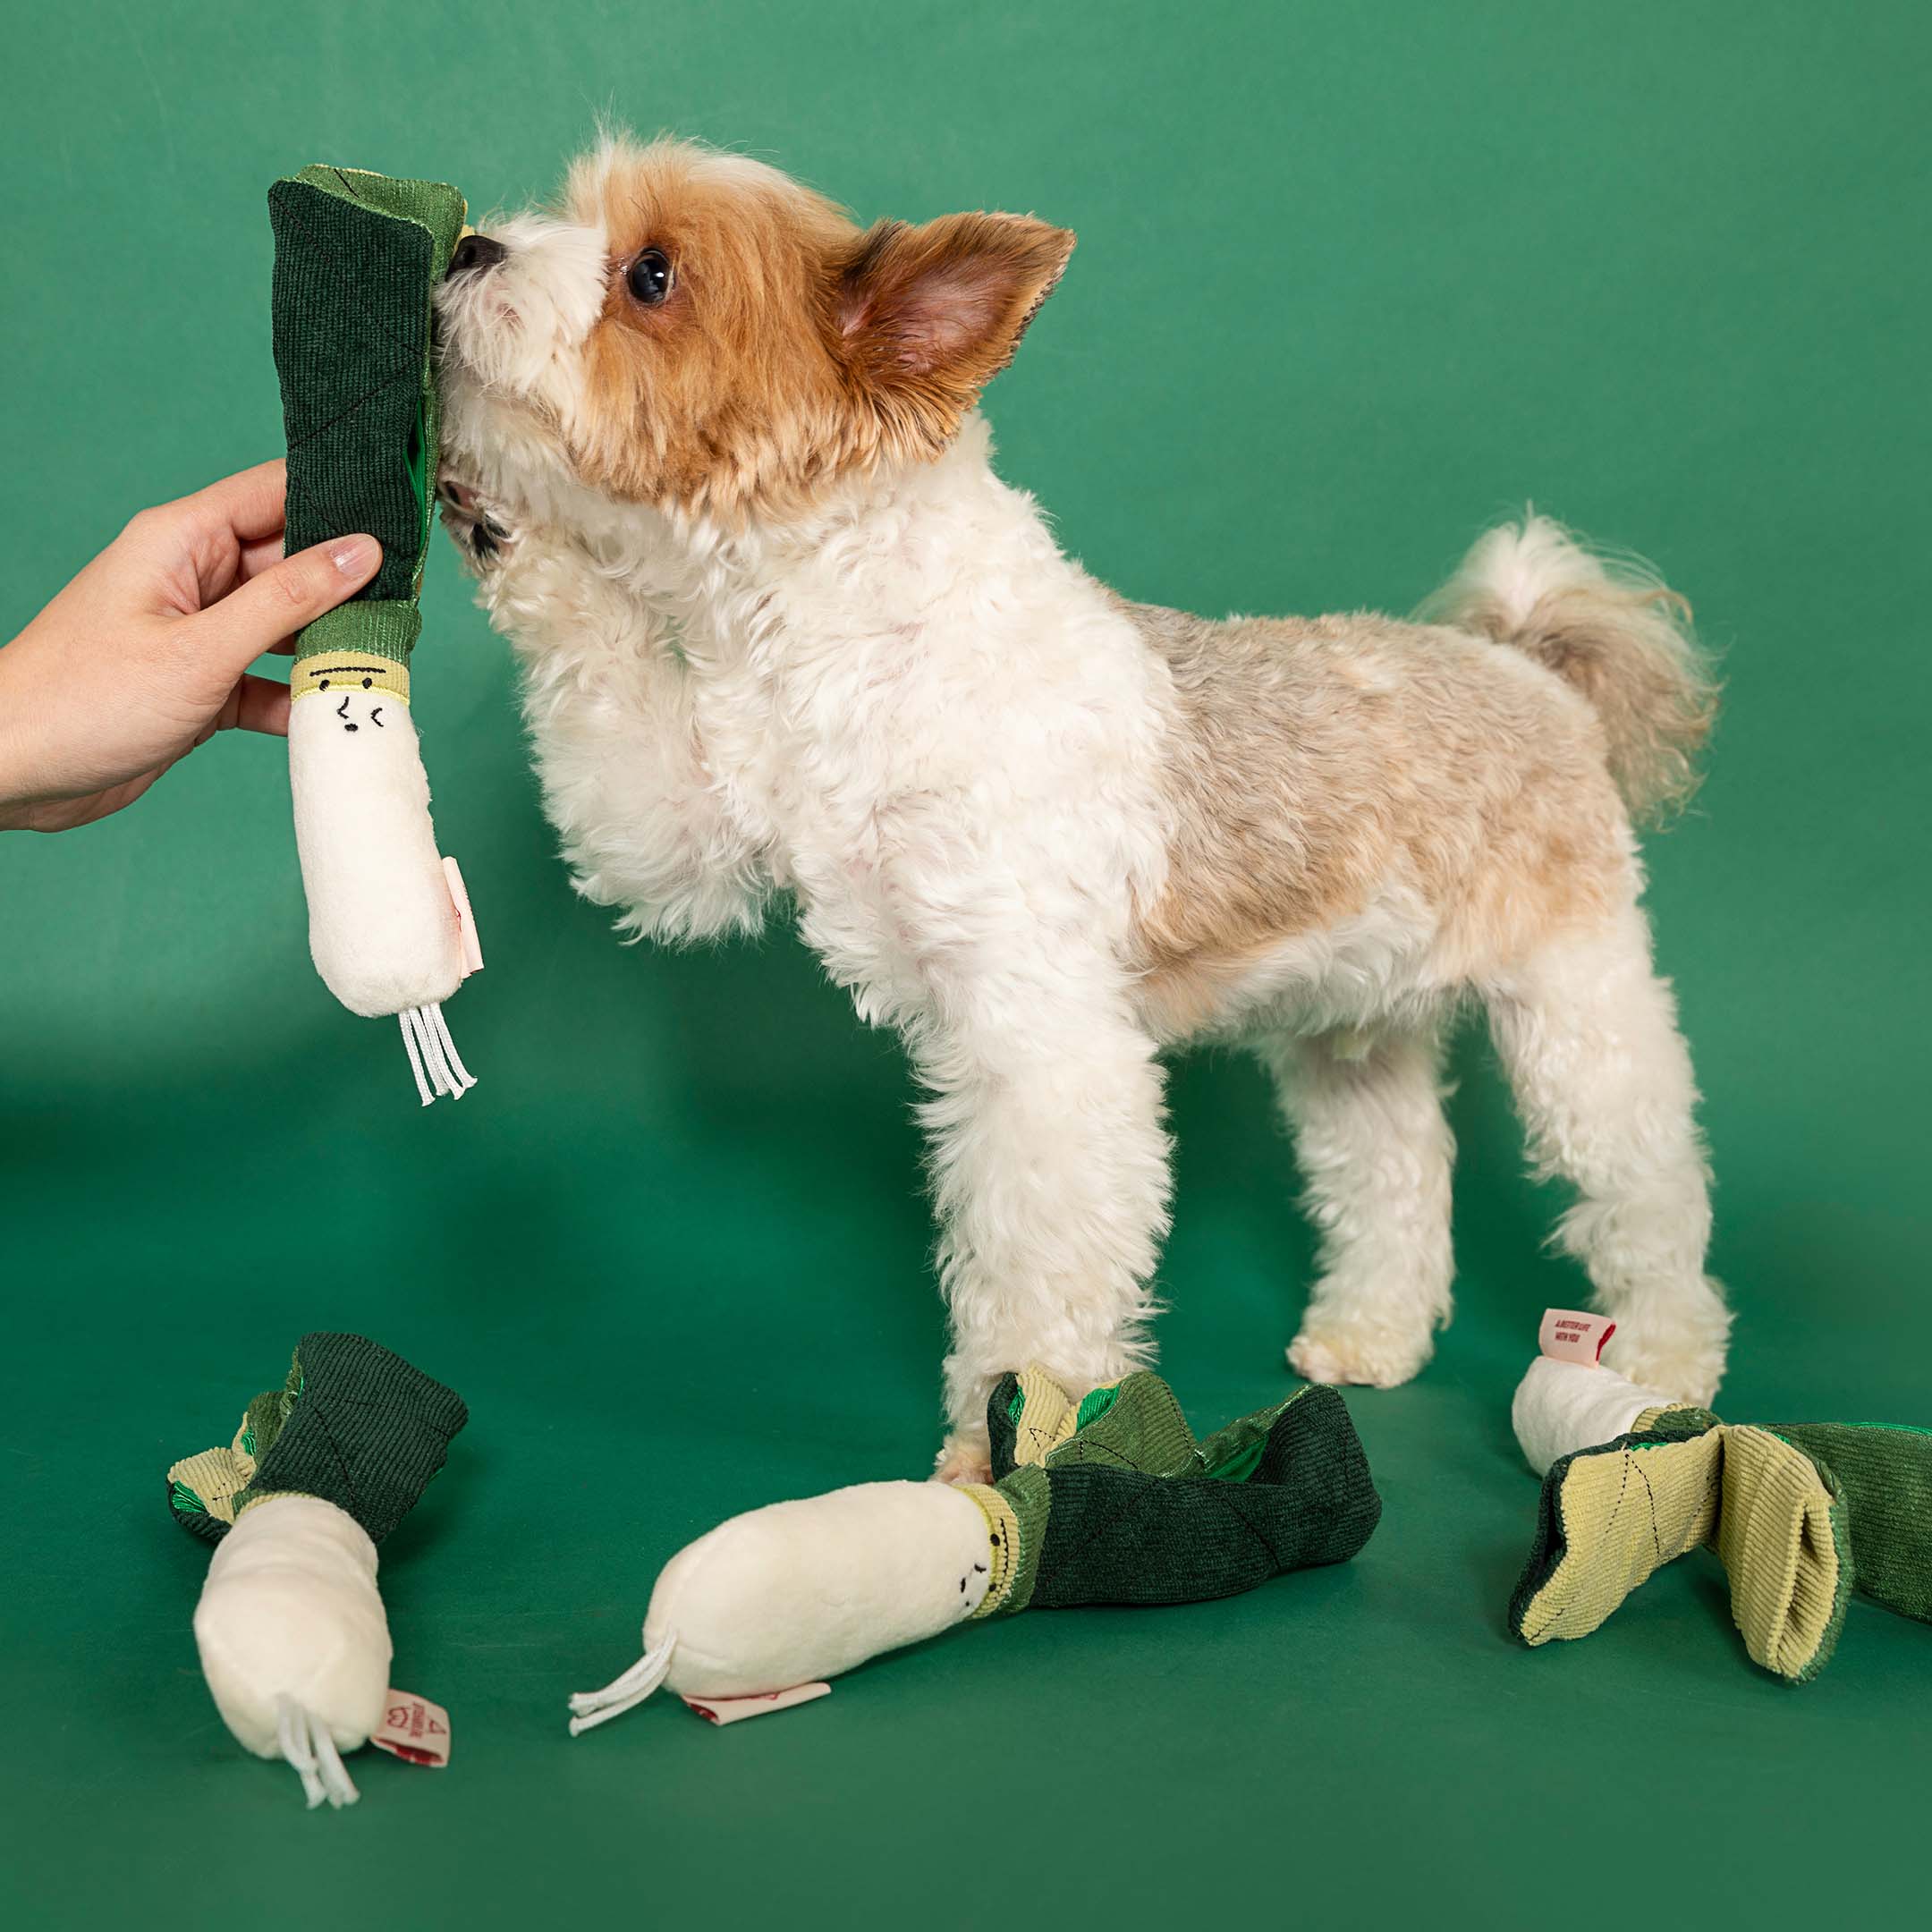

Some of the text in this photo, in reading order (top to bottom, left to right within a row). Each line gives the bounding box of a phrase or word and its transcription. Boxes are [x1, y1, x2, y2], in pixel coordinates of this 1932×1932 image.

[1560, 1320, 1580, 1329] BETTER
[1555, 1332, 1580, 1343] WITH YOU
